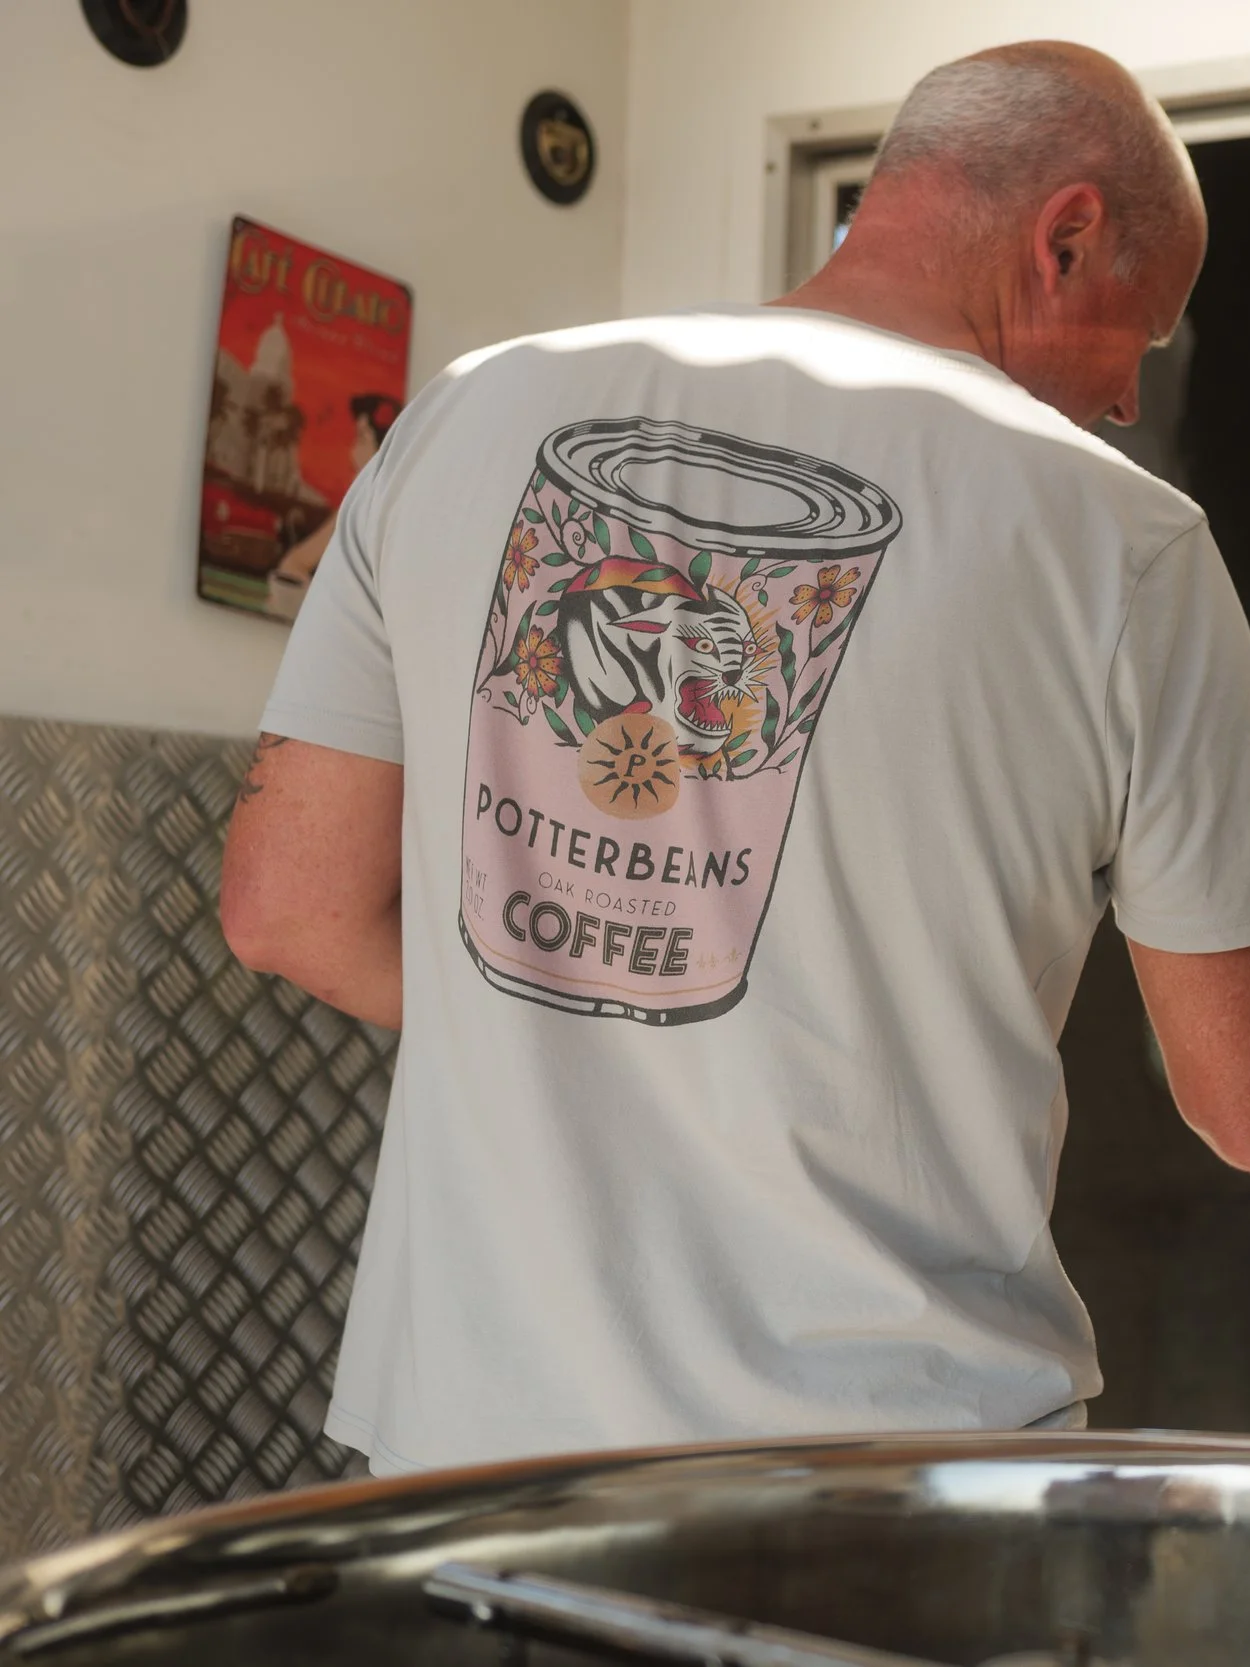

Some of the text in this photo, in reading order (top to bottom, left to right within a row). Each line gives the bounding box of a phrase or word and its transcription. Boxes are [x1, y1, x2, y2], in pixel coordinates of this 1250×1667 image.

[624, 753, 646, 777] P
[476, 783, 752, 889] POTTERBEANS
[538, 872, 676, 917] OAK ROASTED
[502, 890, 694, 976] COFFEE
